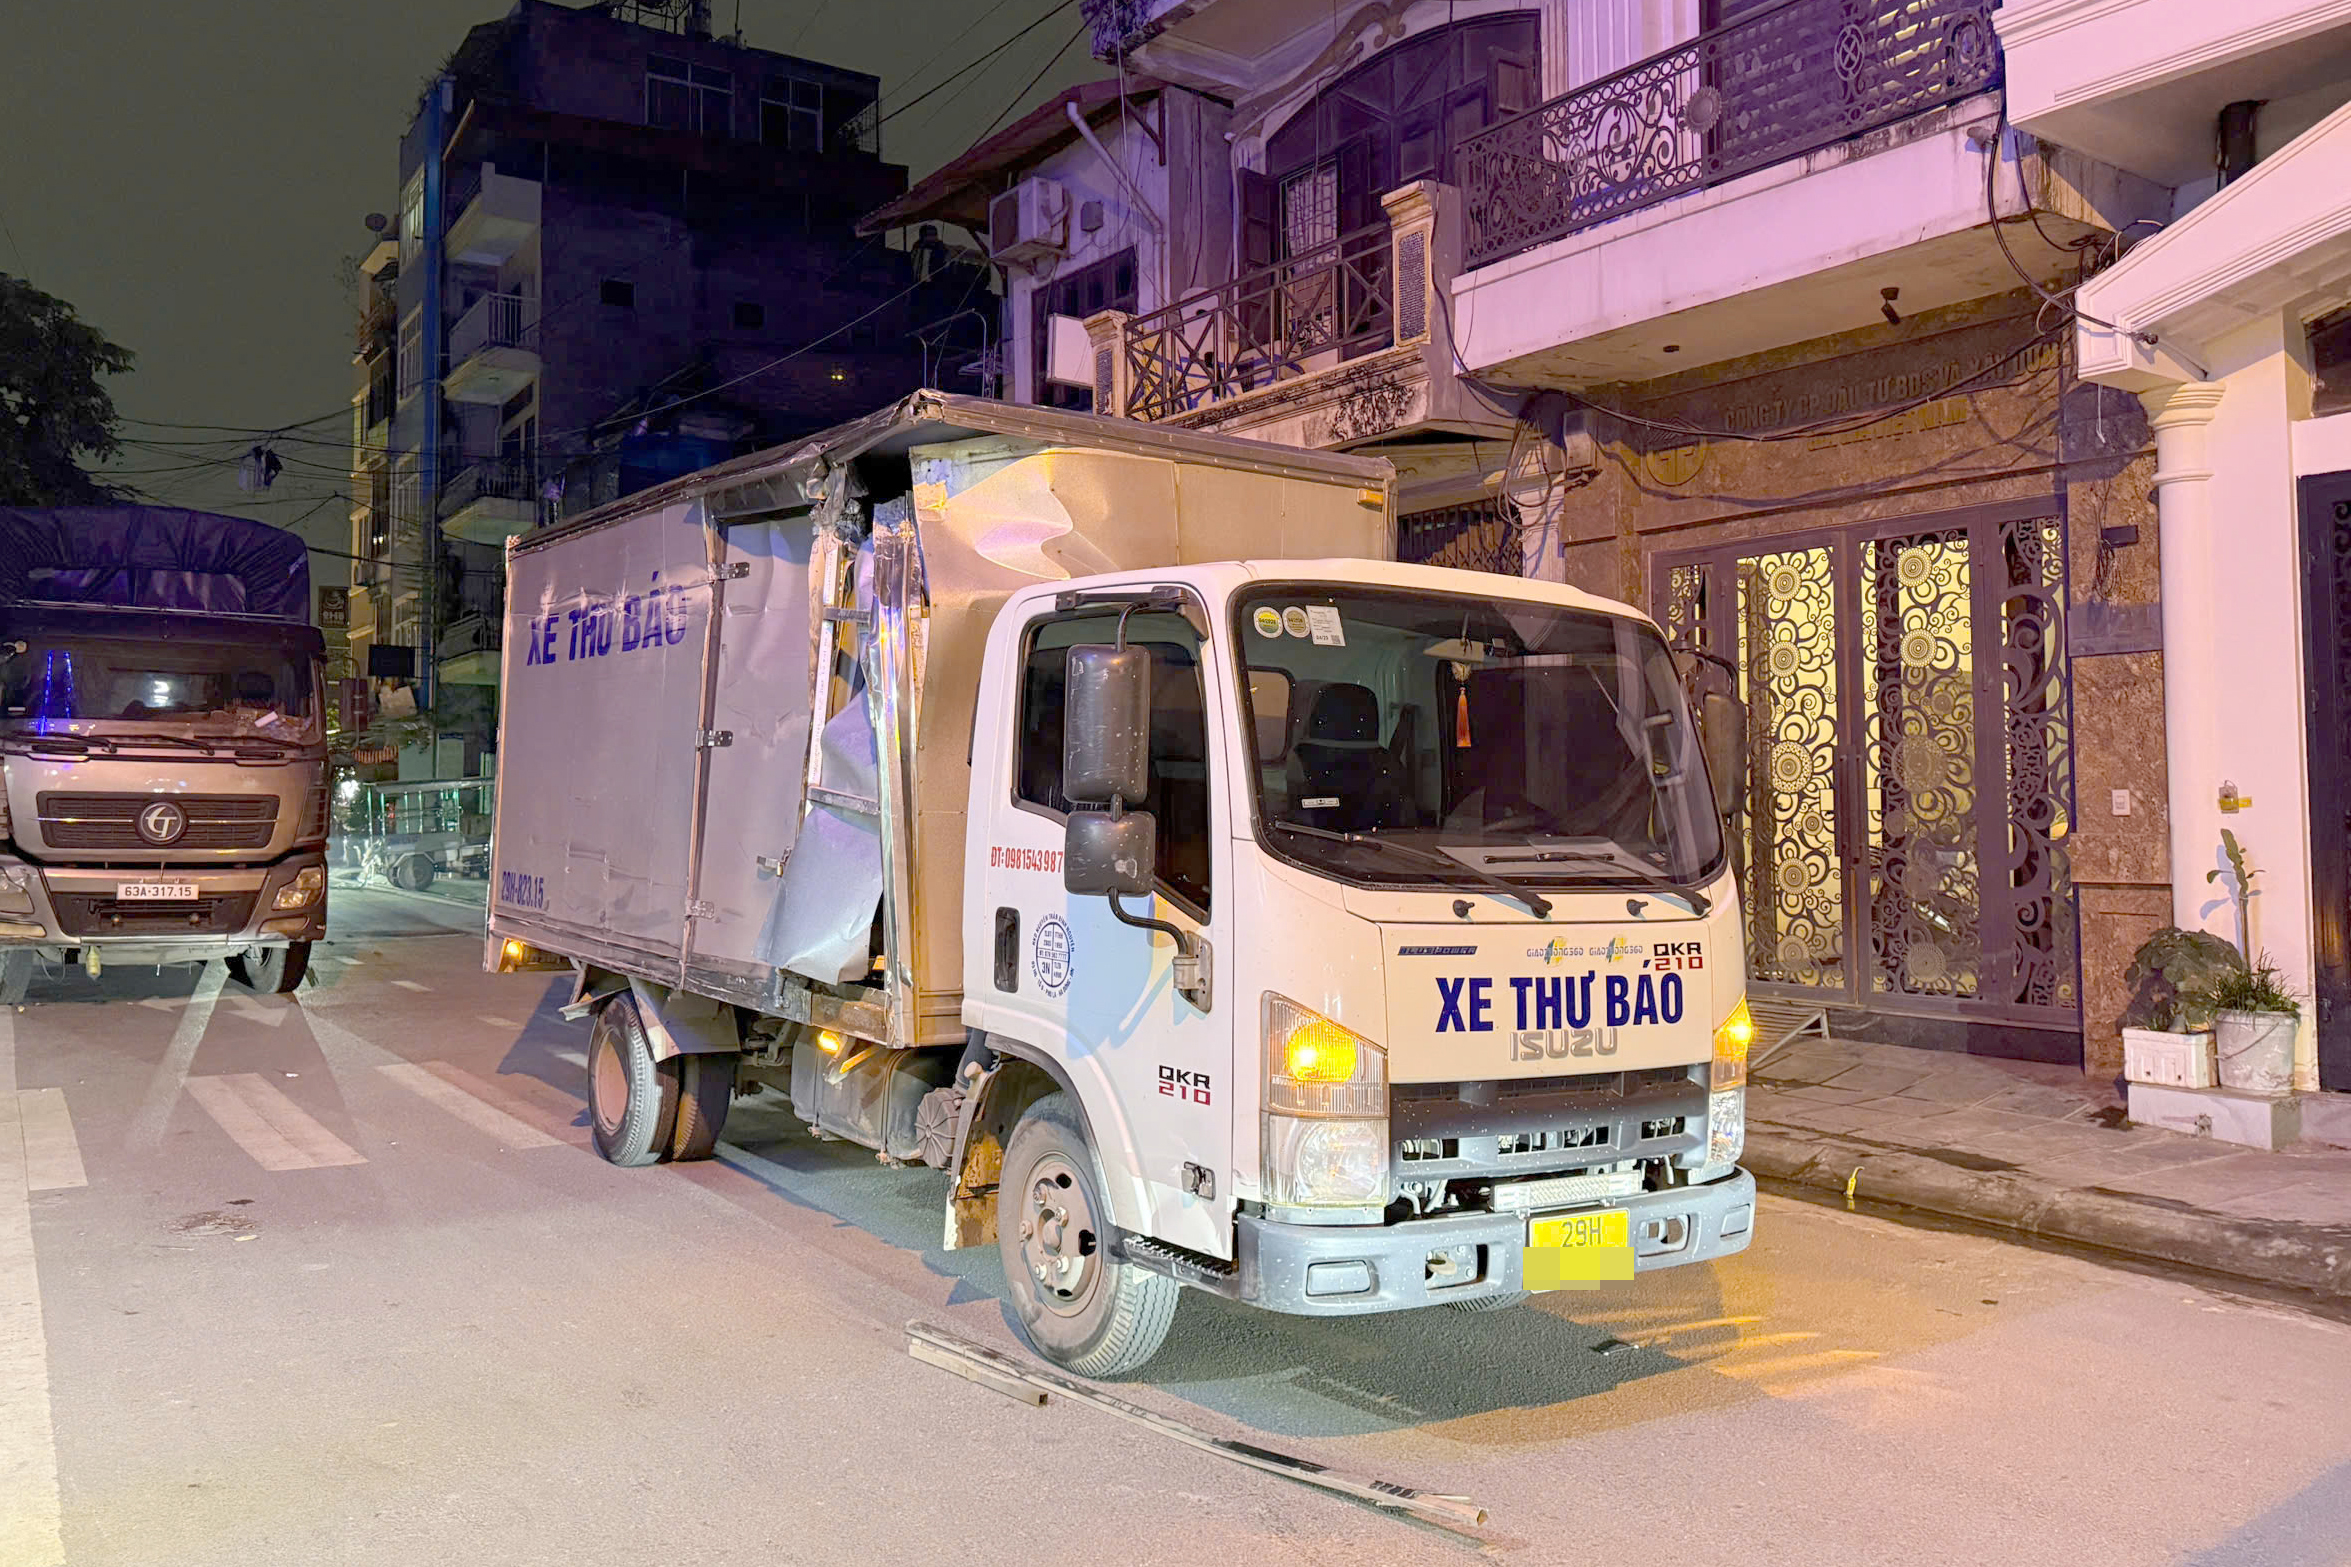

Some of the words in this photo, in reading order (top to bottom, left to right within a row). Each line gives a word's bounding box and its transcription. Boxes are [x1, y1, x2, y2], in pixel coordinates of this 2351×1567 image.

[527, 613, 560, 666] XE
[622, 570, 687, 652] BÁO
[124, 886, 192, 897] 63A-317.15
[1653, 942, 1702, 956] QKR
[1654, 956, 1704, 971] 210
[1435, 977, 1494, 1032] XE
[1509, 970, 1596, 1030] THƯ
[1605, 959, 1683, 1027] BÁO
[1510, 1027, 1618, 1061] ISUZU
[1158, 1064, 1211, 1090] QKR
[1158, 1079, 1211, 1106] 210
[1561, 1217, 1602, 1248] 29H
